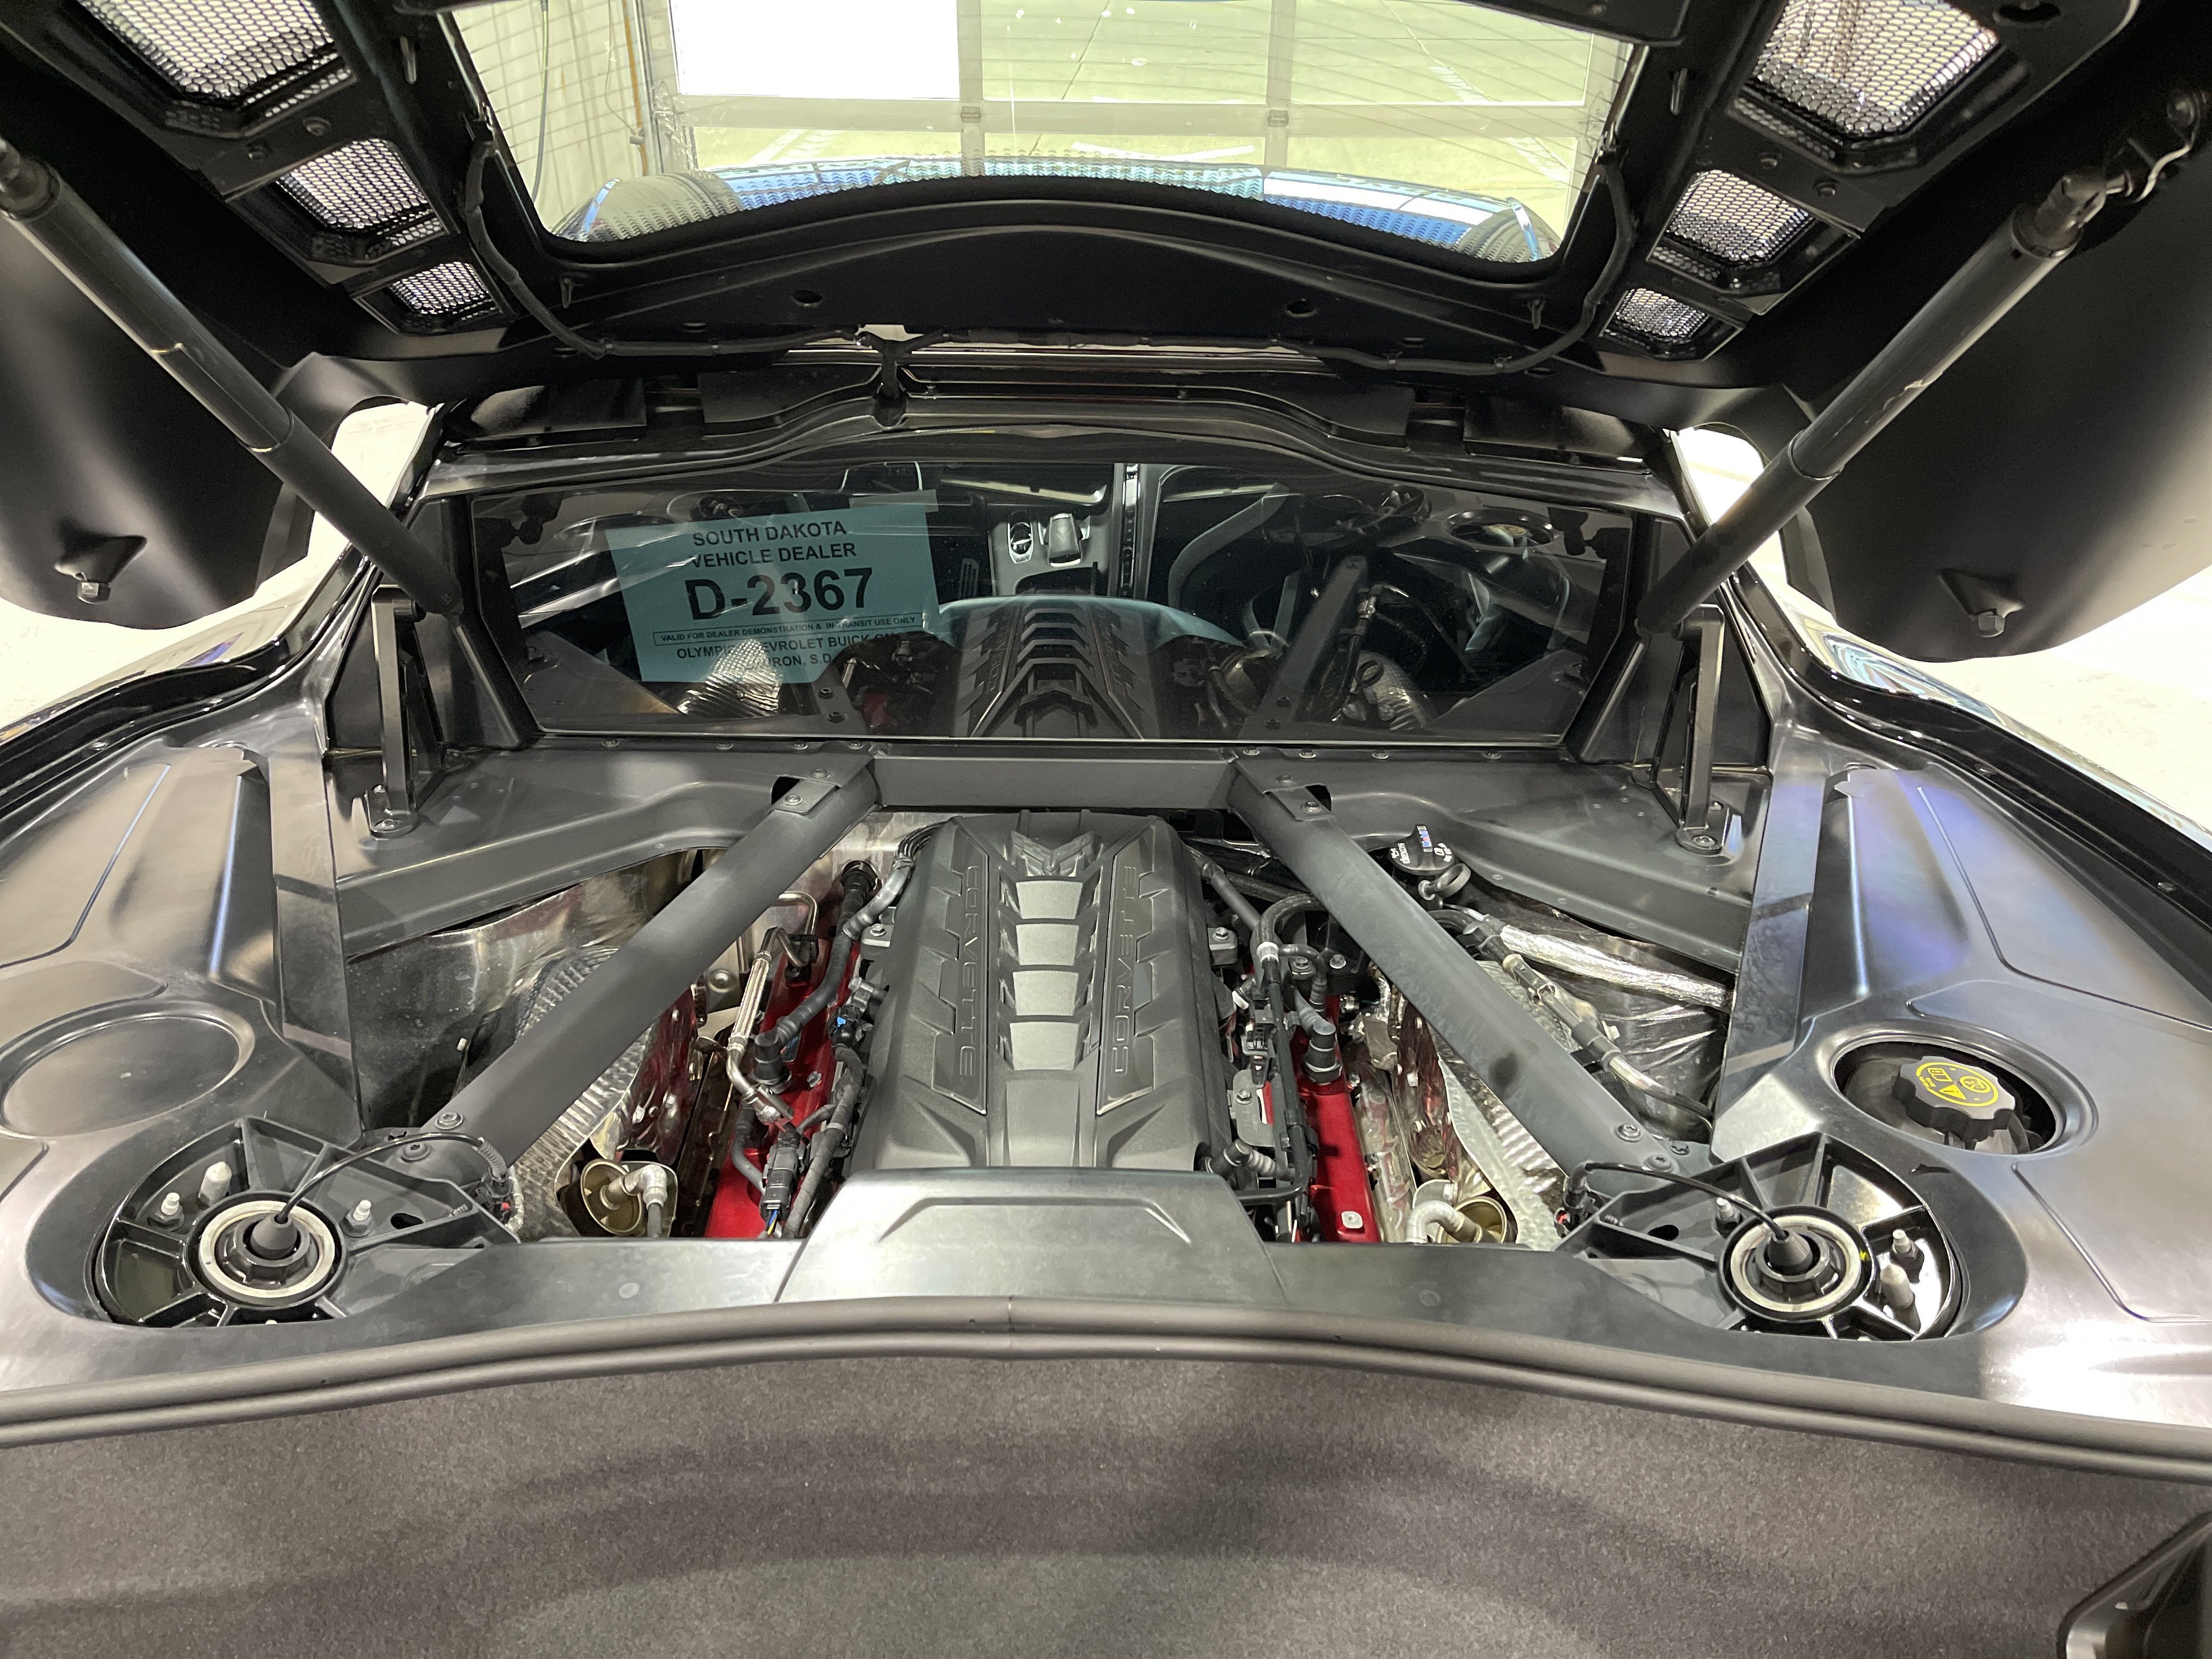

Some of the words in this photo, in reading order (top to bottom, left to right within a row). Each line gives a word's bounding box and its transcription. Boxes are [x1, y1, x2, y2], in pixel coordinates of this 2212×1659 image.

[692, 527, 760, 546] SOUTH
[765, 521, 847, 541] DAKOTA
[690, 549, 774, 568] VEHICLE
[778, 542, 857, 562] DEALER
[685, 567, 873, 620] D-2367
[707, 629, 741, 638] DEALER
[742, 623, 814, 635] DEMONSTRATION
[874, 618, 891, 626] USE
[763, 637, 823, 653] EVROLET
[769, 655, 806, 667] RON,
[959, 865, 979, 1076] CORVETTE
[1110, 866, 1137, 1076] CORVETTE
